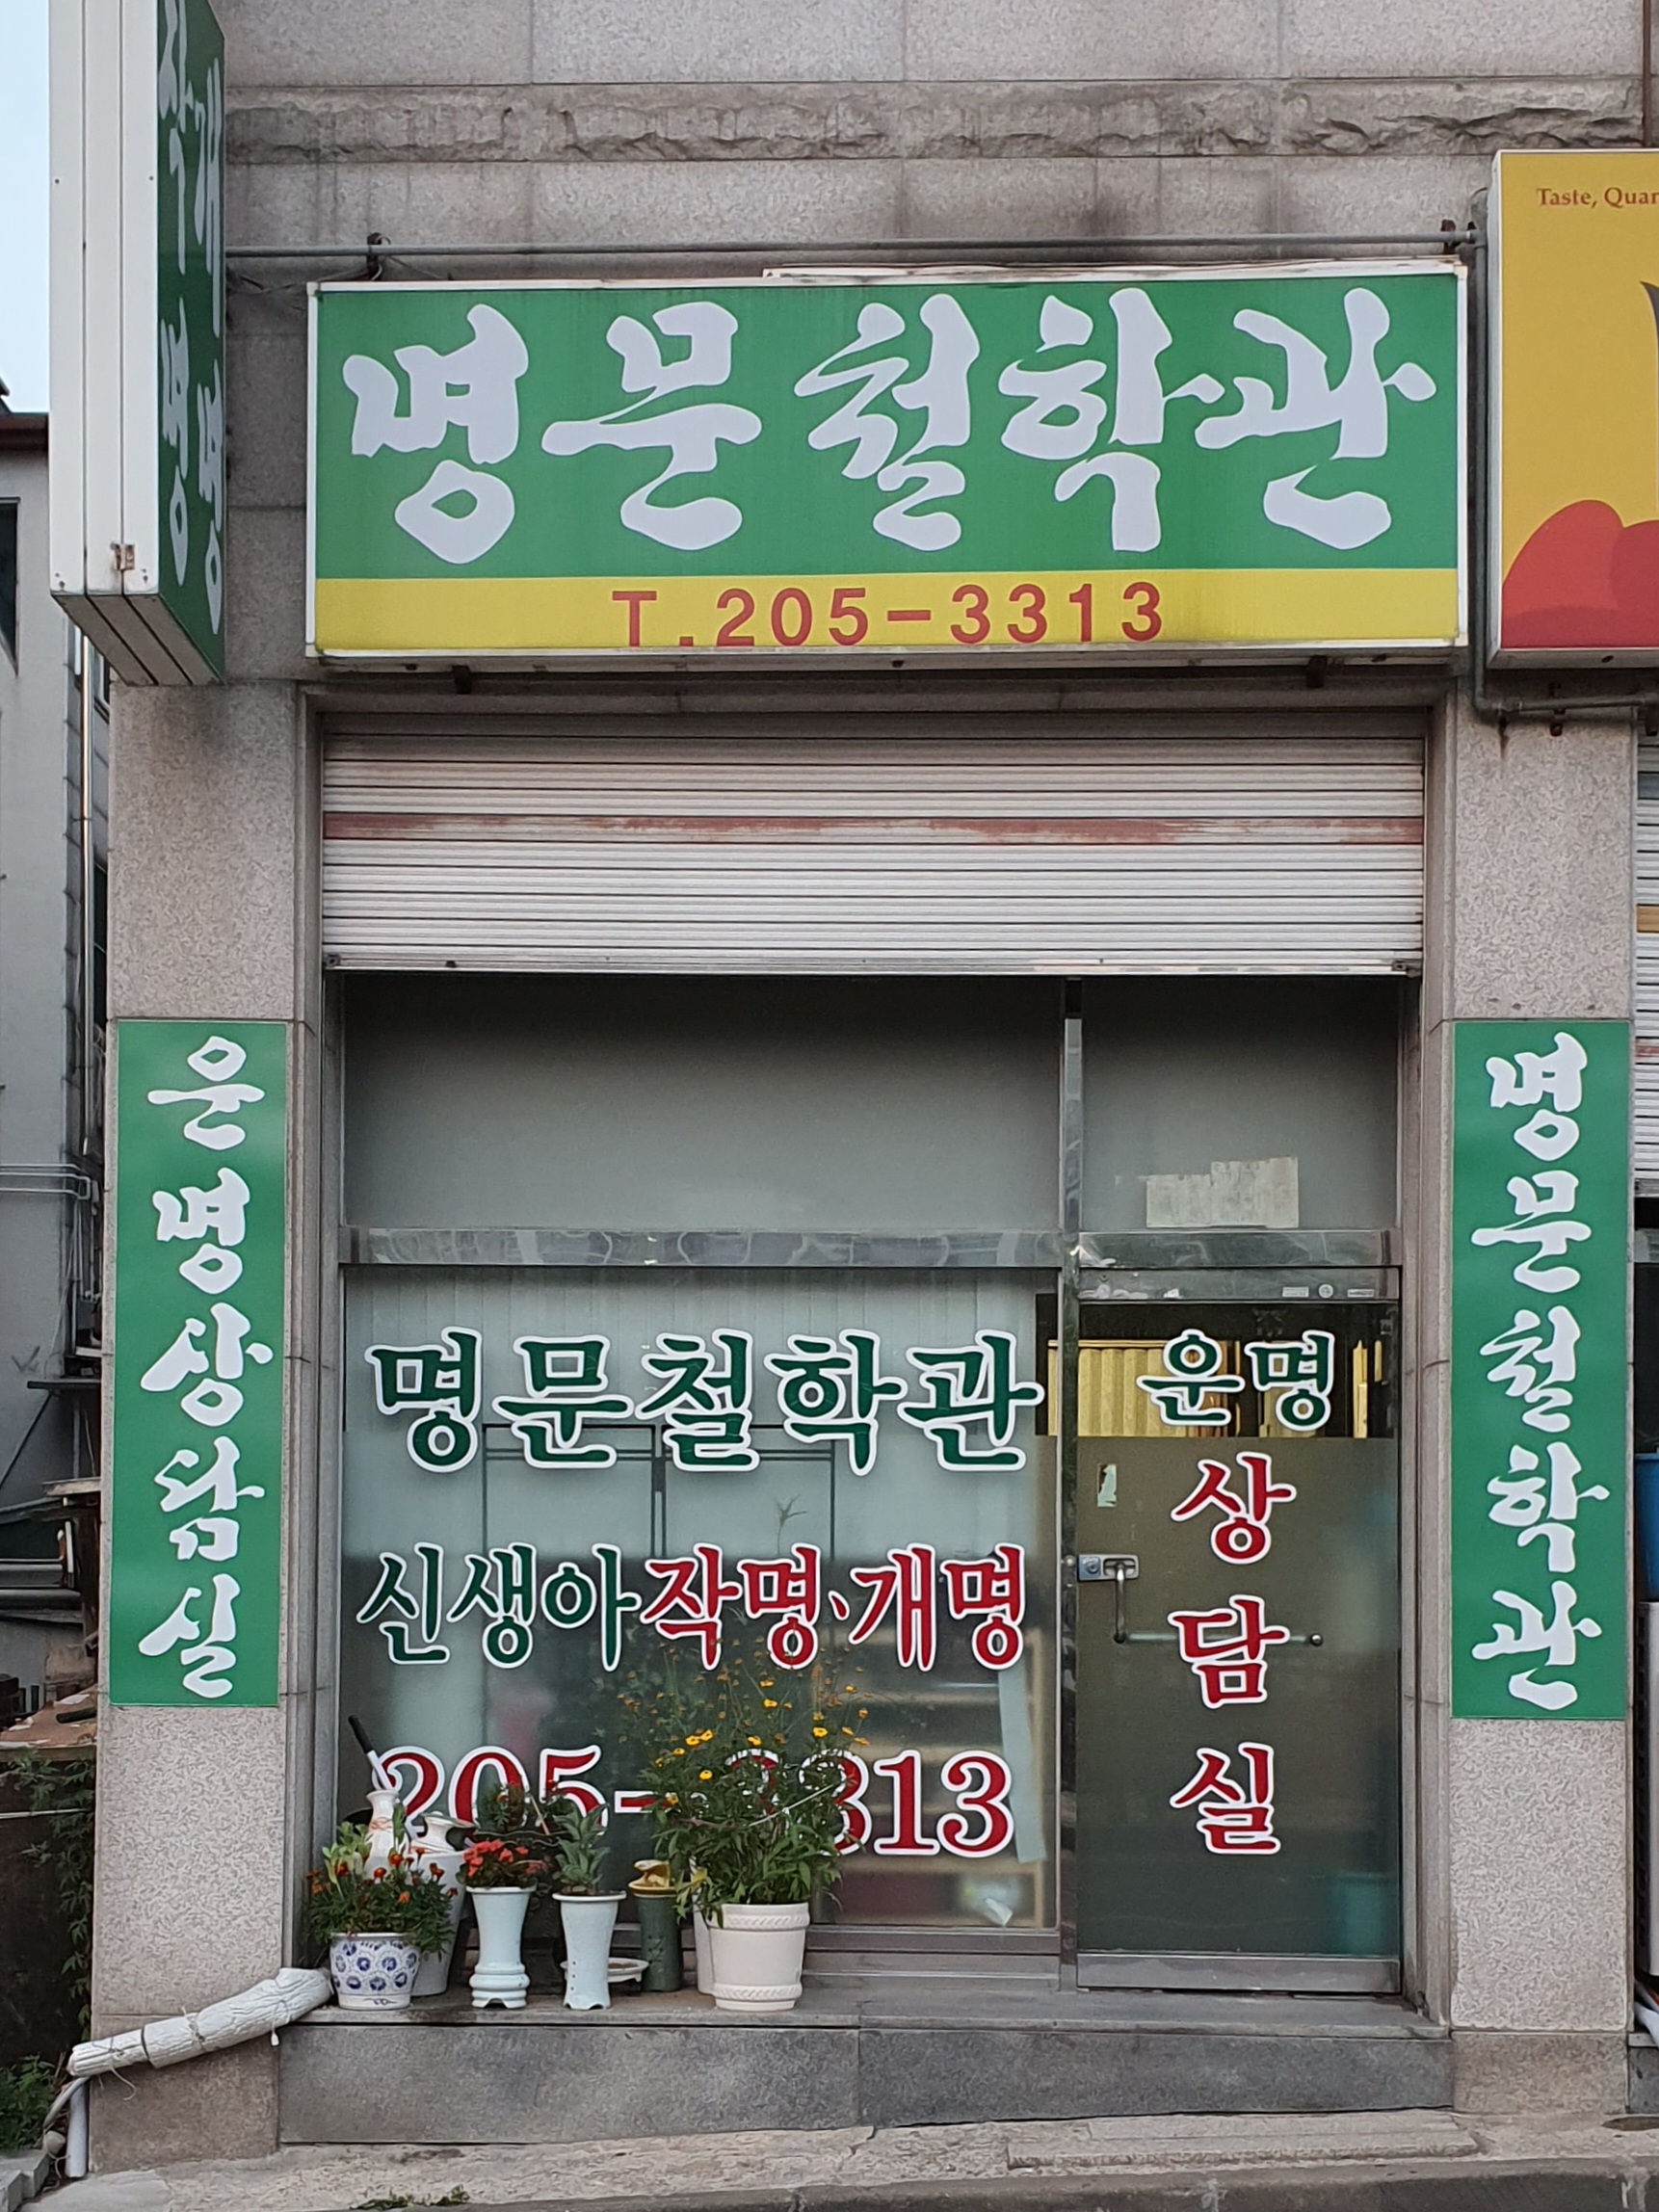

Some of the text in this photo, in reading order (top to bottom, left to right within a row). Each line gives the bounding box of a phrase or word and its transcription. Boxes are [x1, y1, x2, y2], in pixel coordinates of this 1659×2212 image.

[1537, 187, 1597, 209] Taste,
[343, 288, 1436, 565] 명문철학관
[611, 582, 1162, 648] T.205-3313
[138, 1036, 274, 1698] 운명상담실
[364, 1326, 1045, 1476] 명문철학관
[1136, 1329, 1335, 1431] 운명
[1471, 1032, 1610, 1711] 명문철학관
